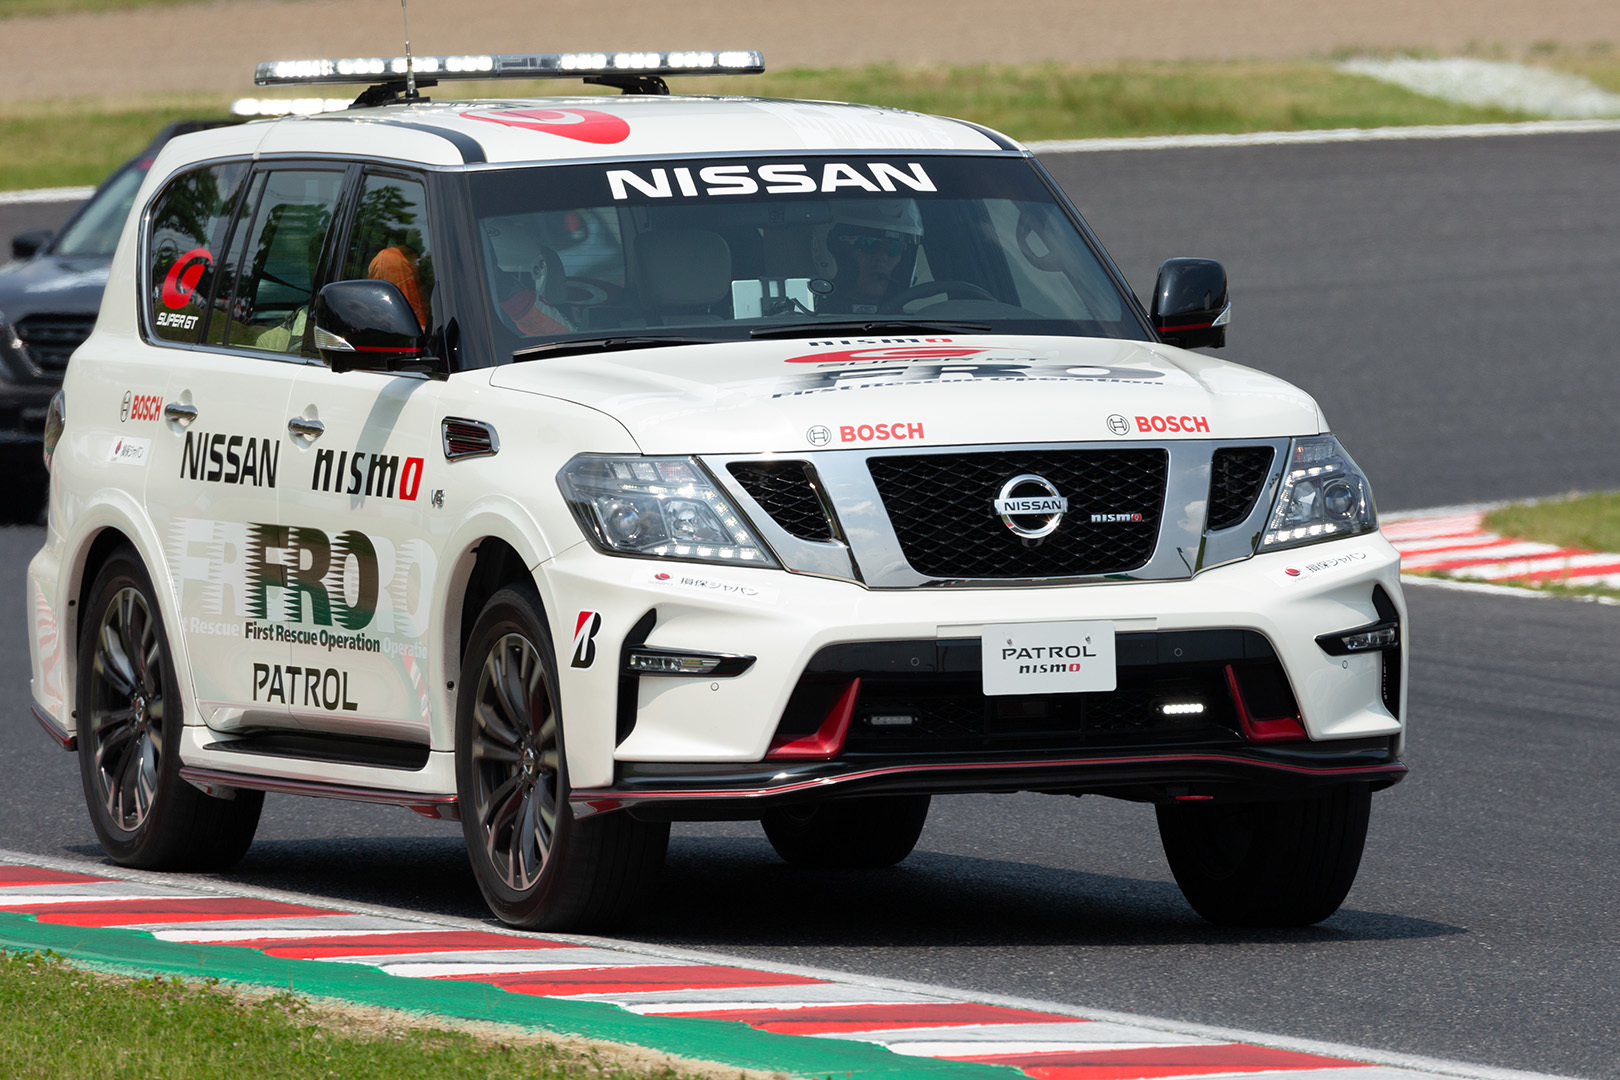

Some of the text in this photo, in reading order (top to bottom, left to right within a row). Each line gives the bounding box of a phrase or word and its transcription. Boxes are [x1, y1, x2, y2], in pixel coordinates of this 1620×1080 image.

[606, 162, 938, 200] NISSAN
[156, 312, 199, 330] SUPER GT
[131, 395, 163, 421] BOSCH
[840, 422, 925, 443] BOSCH
[1134, 415, 1211, 433] BOSCH
[180, 431, 280, 488] NISSAN
[311, 448, 425, 501] nismo
[1004, 501, 1062, 511] NISSAN
[1091, 513, 1142, 523] nismo
[245, 521, 379, 631] FRO
[190, 616, 240, 637] Rescue
[245, 621, 274, 641] First
[276, 625, 318, 645] Rescue
[319, 630, 381, 653] Operation
[1002, 645, 1097, 660] PATROL
[1019, 663, 1081, 674] nismo
[253, 663, 358, 711] PATROL
